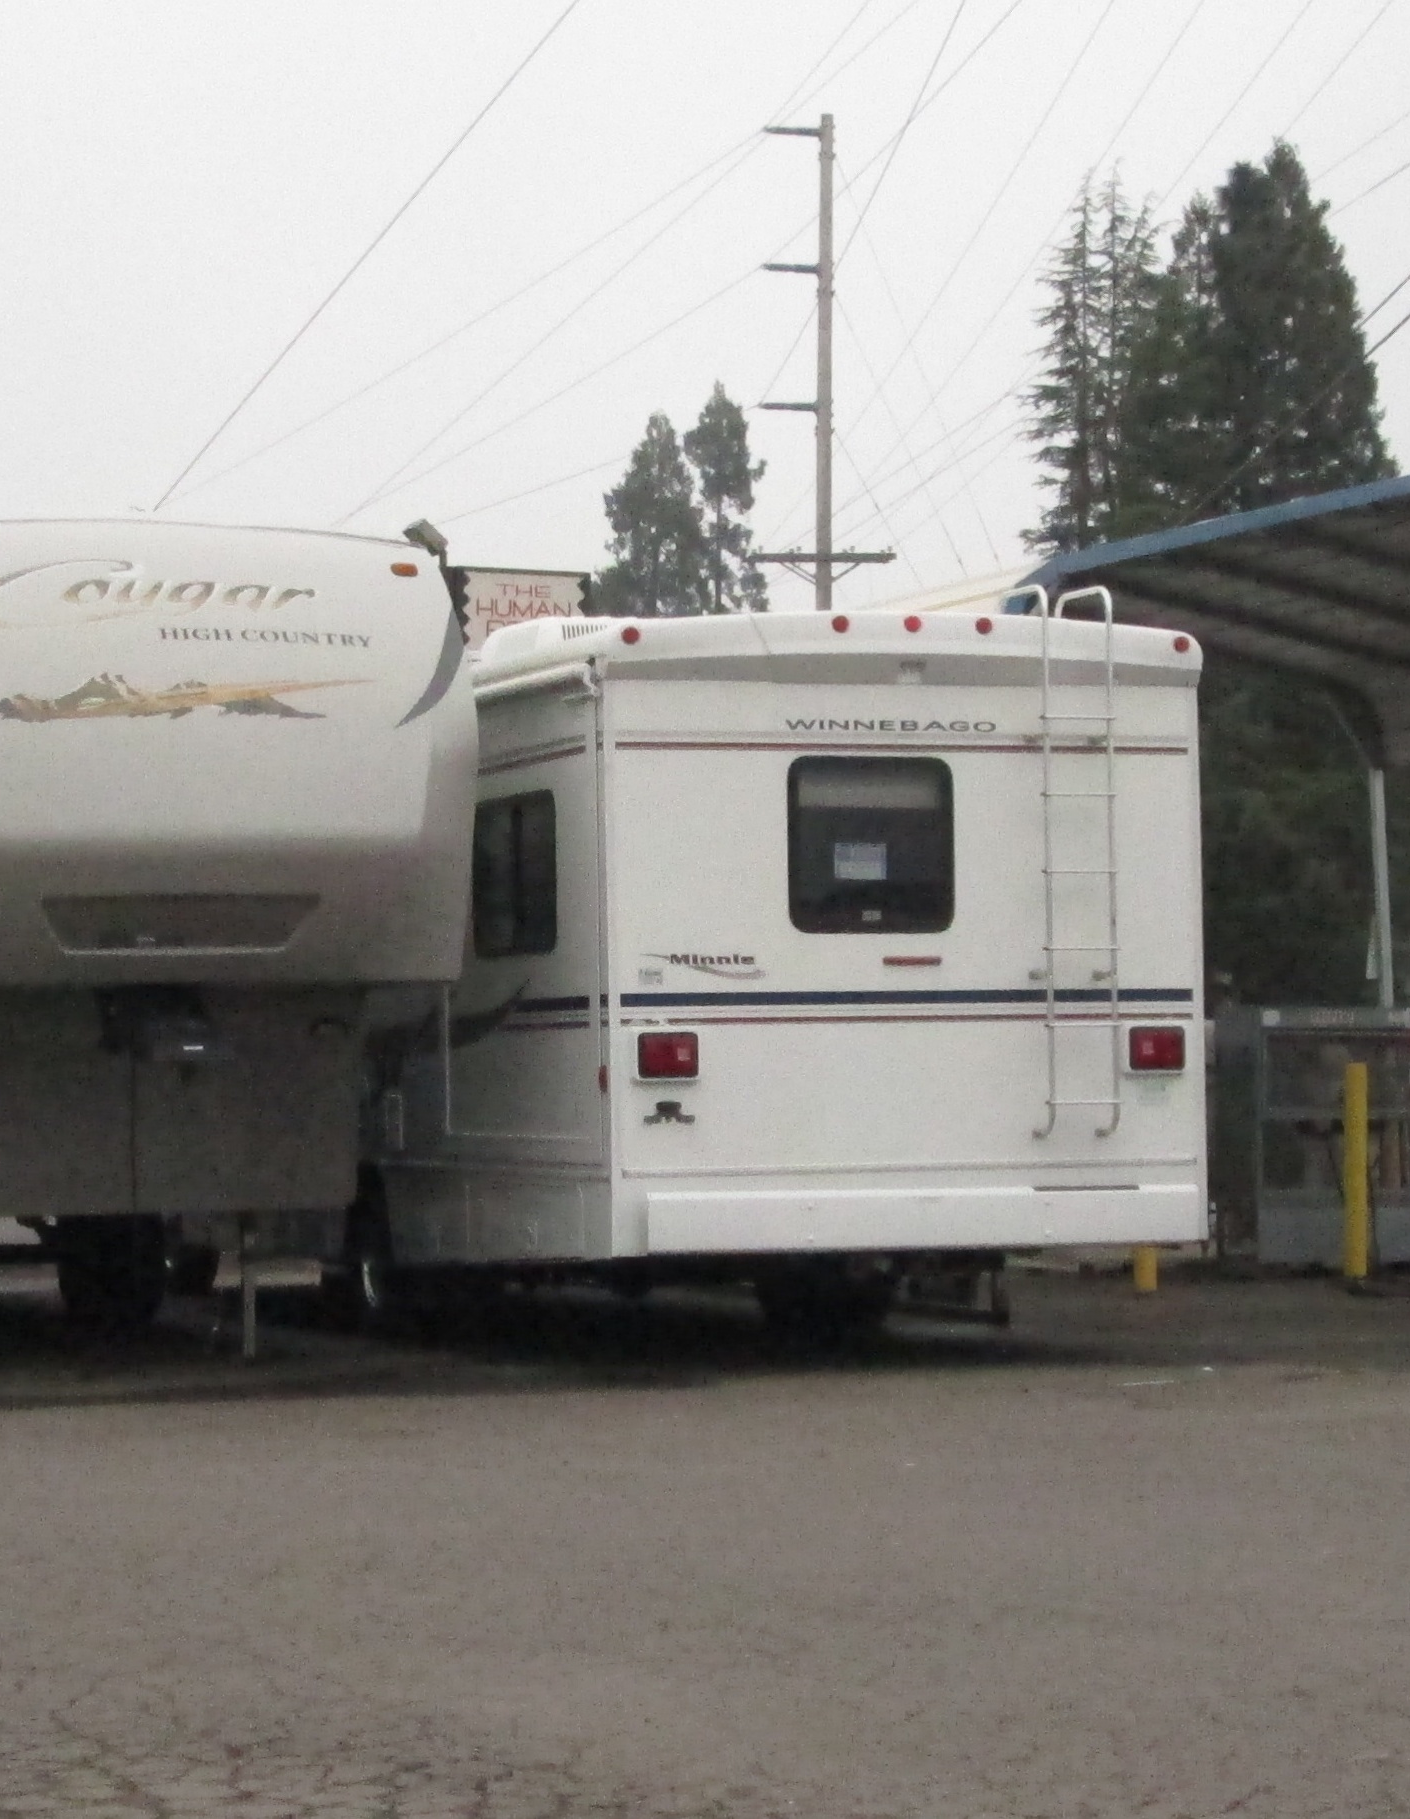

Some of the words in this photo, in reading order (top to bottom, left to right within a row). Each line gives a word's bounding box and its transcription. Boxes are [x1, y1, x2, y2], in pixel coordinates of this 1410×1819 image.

[496, 582, 551, 598] THE
[475, 597, 572, 618] HUMAN
[159, 627, 233, 642] HIGH
[240, 628, 372, 648] COUNTRY
[785, 718, 997, 733] WINNEBAGO
[669, 953, 756, 966] Minnie
